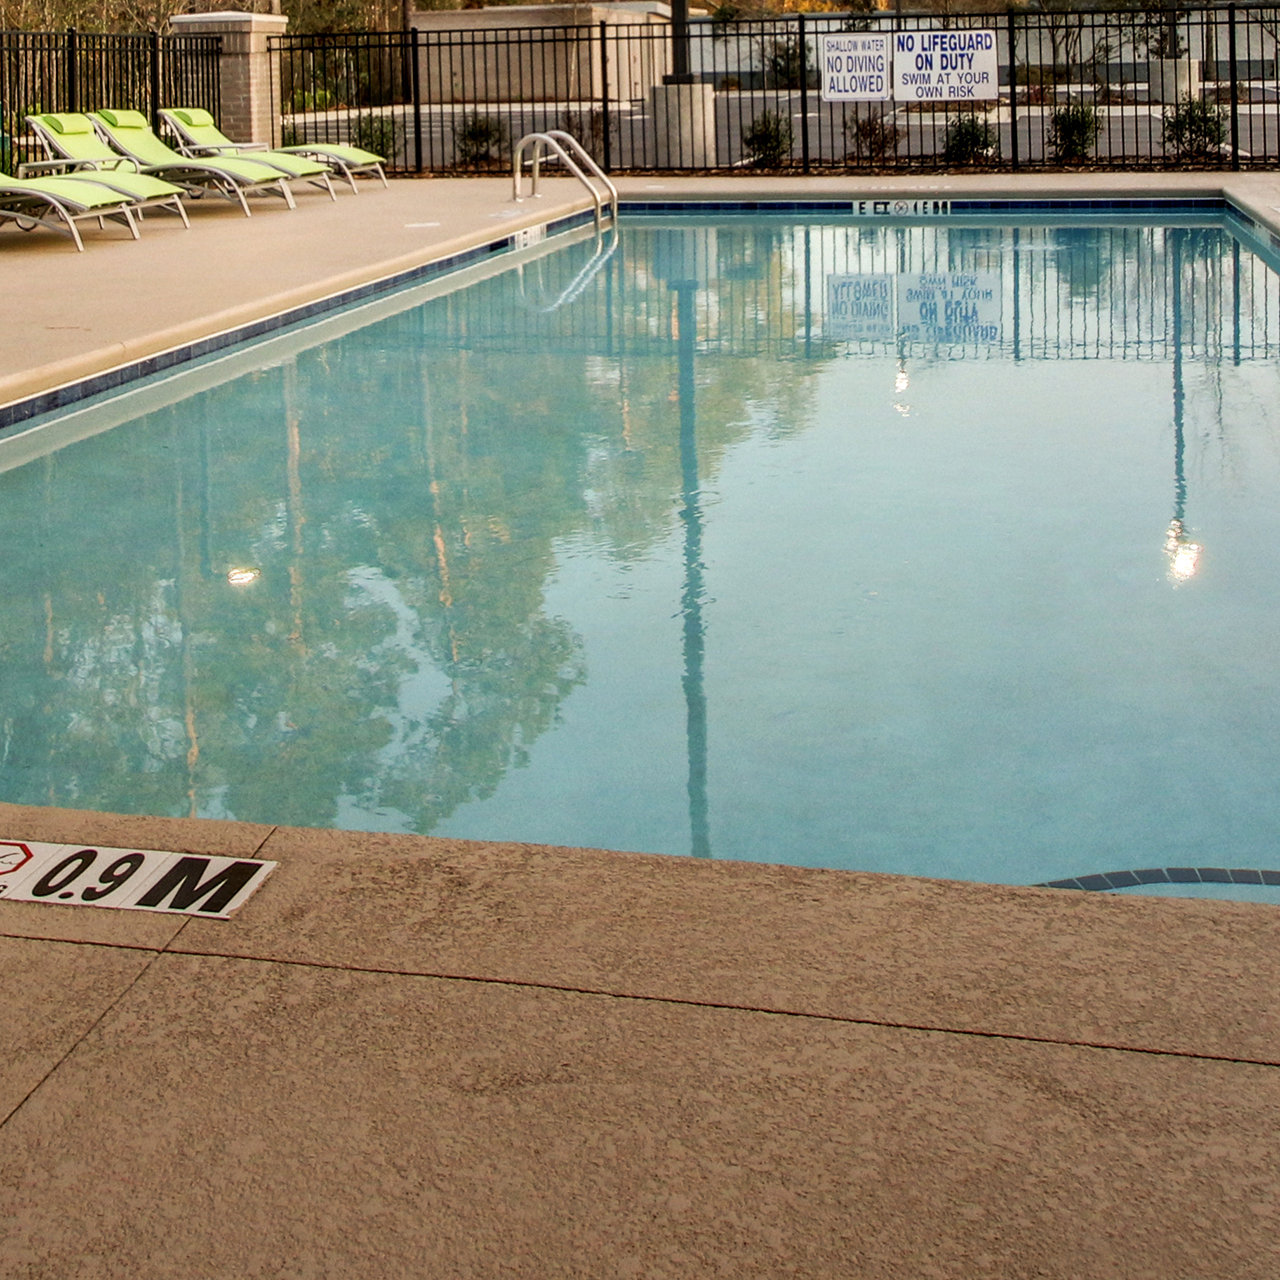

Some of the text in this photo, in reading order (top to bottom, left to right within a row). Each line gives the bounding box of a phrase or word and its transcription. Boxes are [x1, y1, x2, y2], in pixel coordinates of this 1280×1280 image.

[826, 39, 884, 53] SHALLOW WATER
[897, 33, 993, 52] NO LIFEGUARD
[827, 56, 884, 73] NO DIVING
[915, 53, 974, 71] ON DUTY
[828, 75, 884, 93] ALLOWED
[902, 72, 989, 85] SWIM AT YOUR
[916, 85, 975, 98] OWN RISK
[31, 848, 146, 902] 0.9
[134, 858, 263, 913] M
